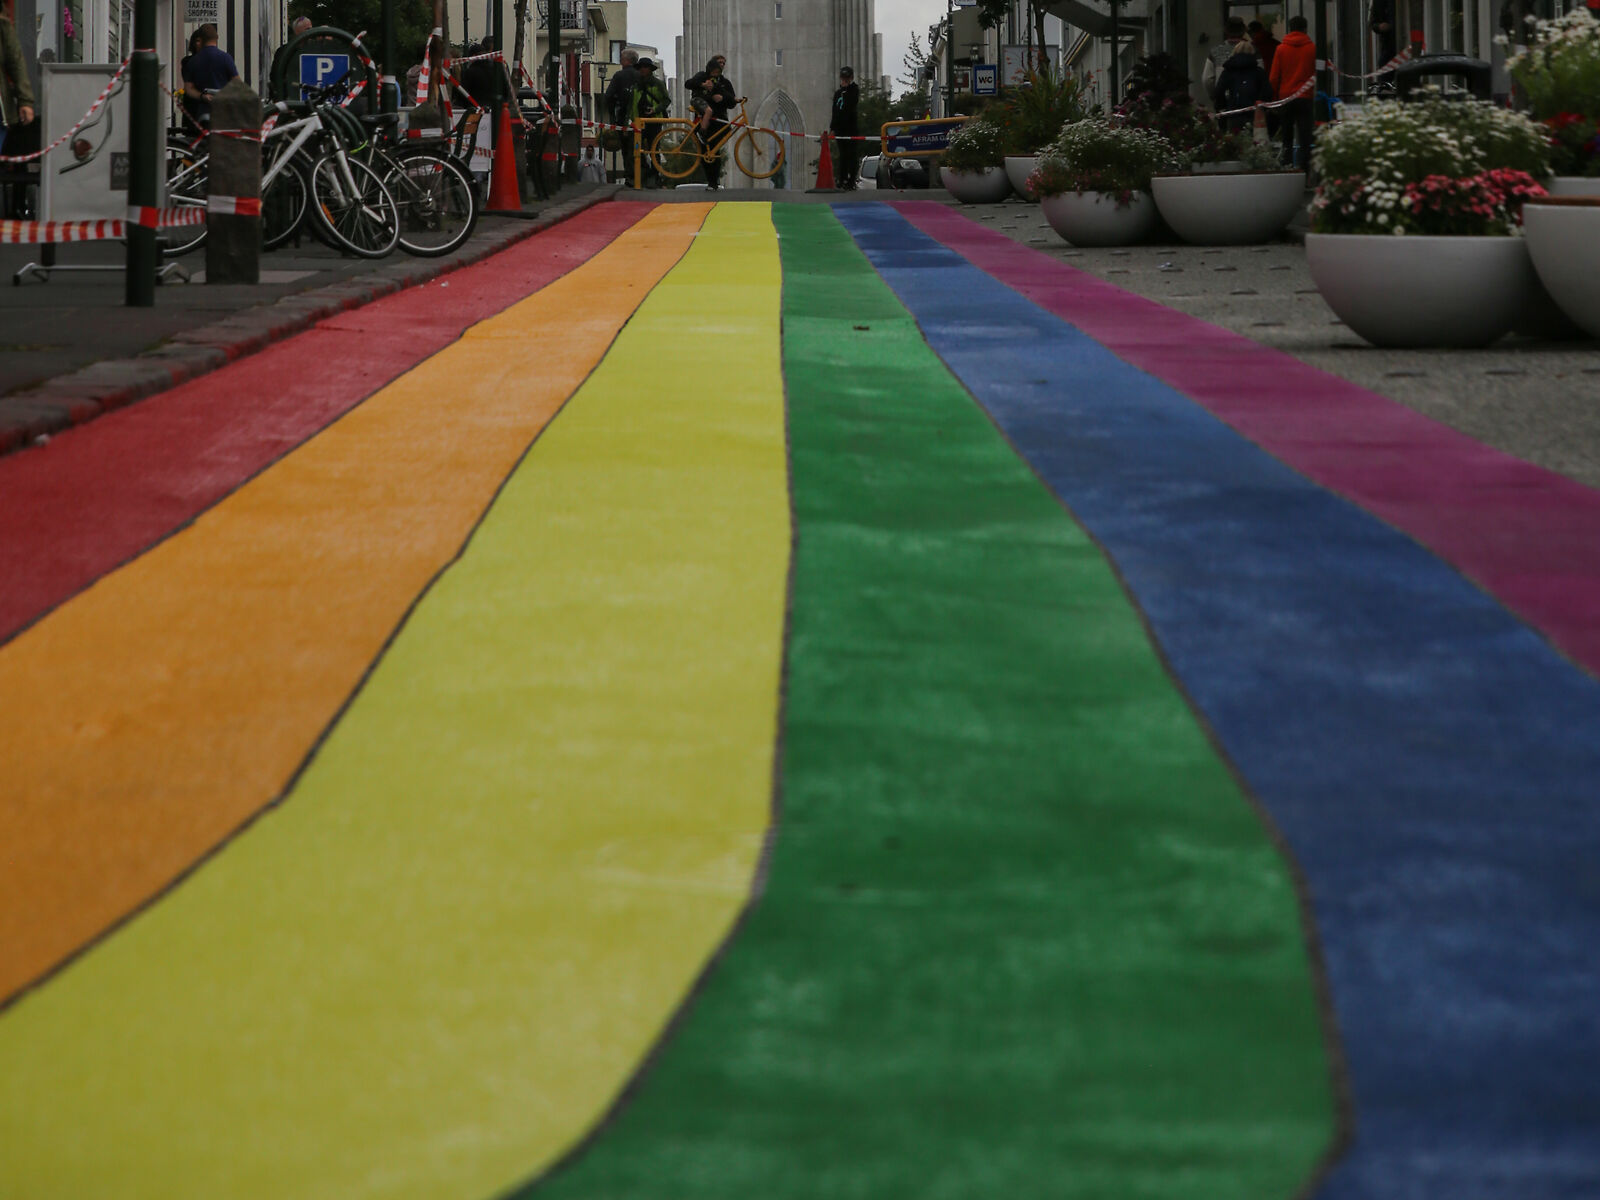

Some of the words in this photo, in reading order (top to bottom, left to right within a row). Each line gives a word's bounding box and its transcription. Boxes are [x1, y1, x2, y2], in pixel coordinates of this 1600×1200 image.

[188, 0, 200, 9] TAX
[202, 0, 218, 9] FREE
[188, 9, 218, 17] SHOPPING
[316, 57, 334, 81] P
[978, 76, 993, 84] WC
